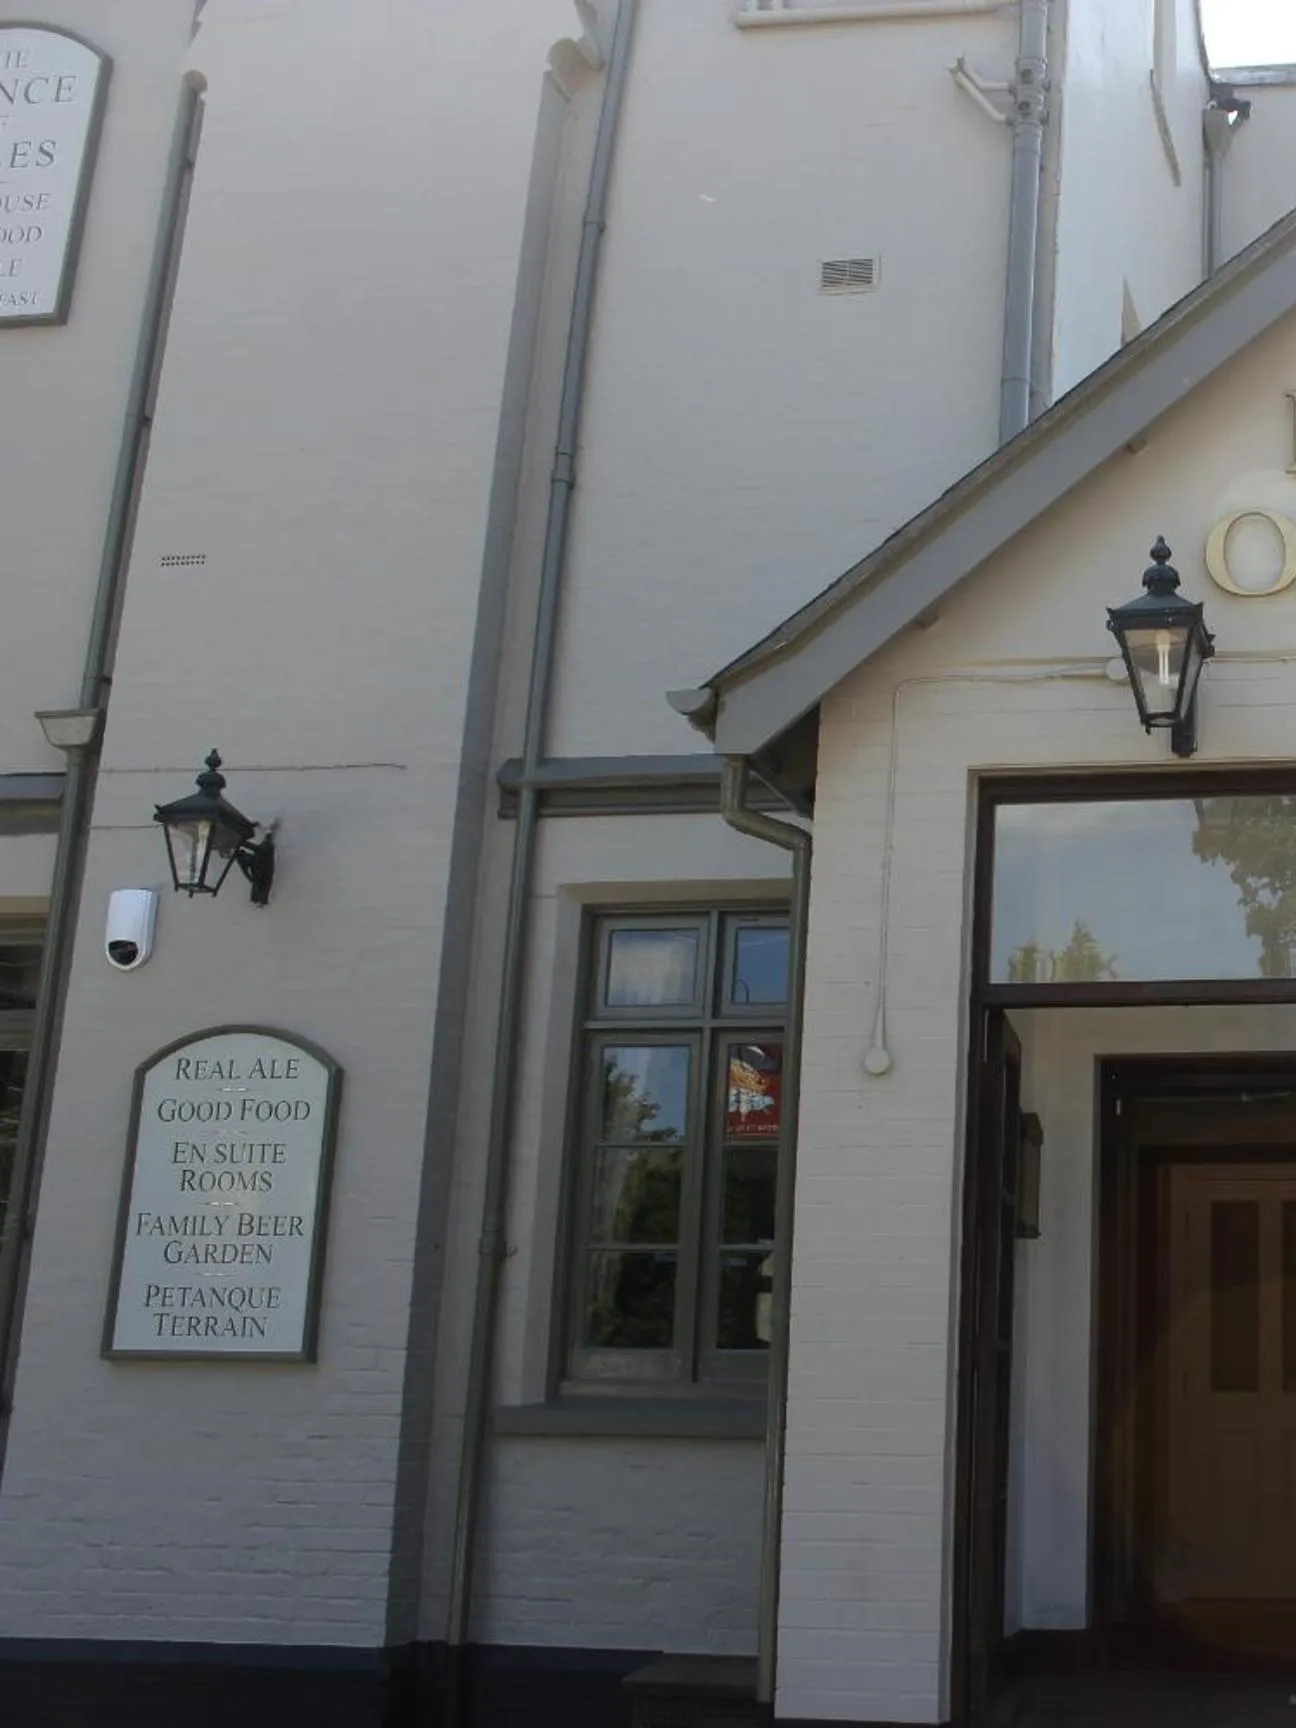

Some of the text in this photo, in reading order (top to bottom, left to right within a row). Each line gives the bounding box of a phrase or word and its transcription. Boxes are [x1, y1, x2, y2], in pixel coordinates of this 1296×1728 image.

[175, 1057, 300, 1080] REAL ALE
[157, 1098, 311, 1122] GOOD FOOD
[172, 1141, 287, 1164] EN SUITE
[180, 1170, 274, 1192] ROOMS
[136, 1213, 305, 1236] FAMILY BEER
[163, 1240, 274, 1264] GARDEN
[143, 1285, 282, 1311] PETANQUE
[153, 1313, 267, 1338] TERRAIN
